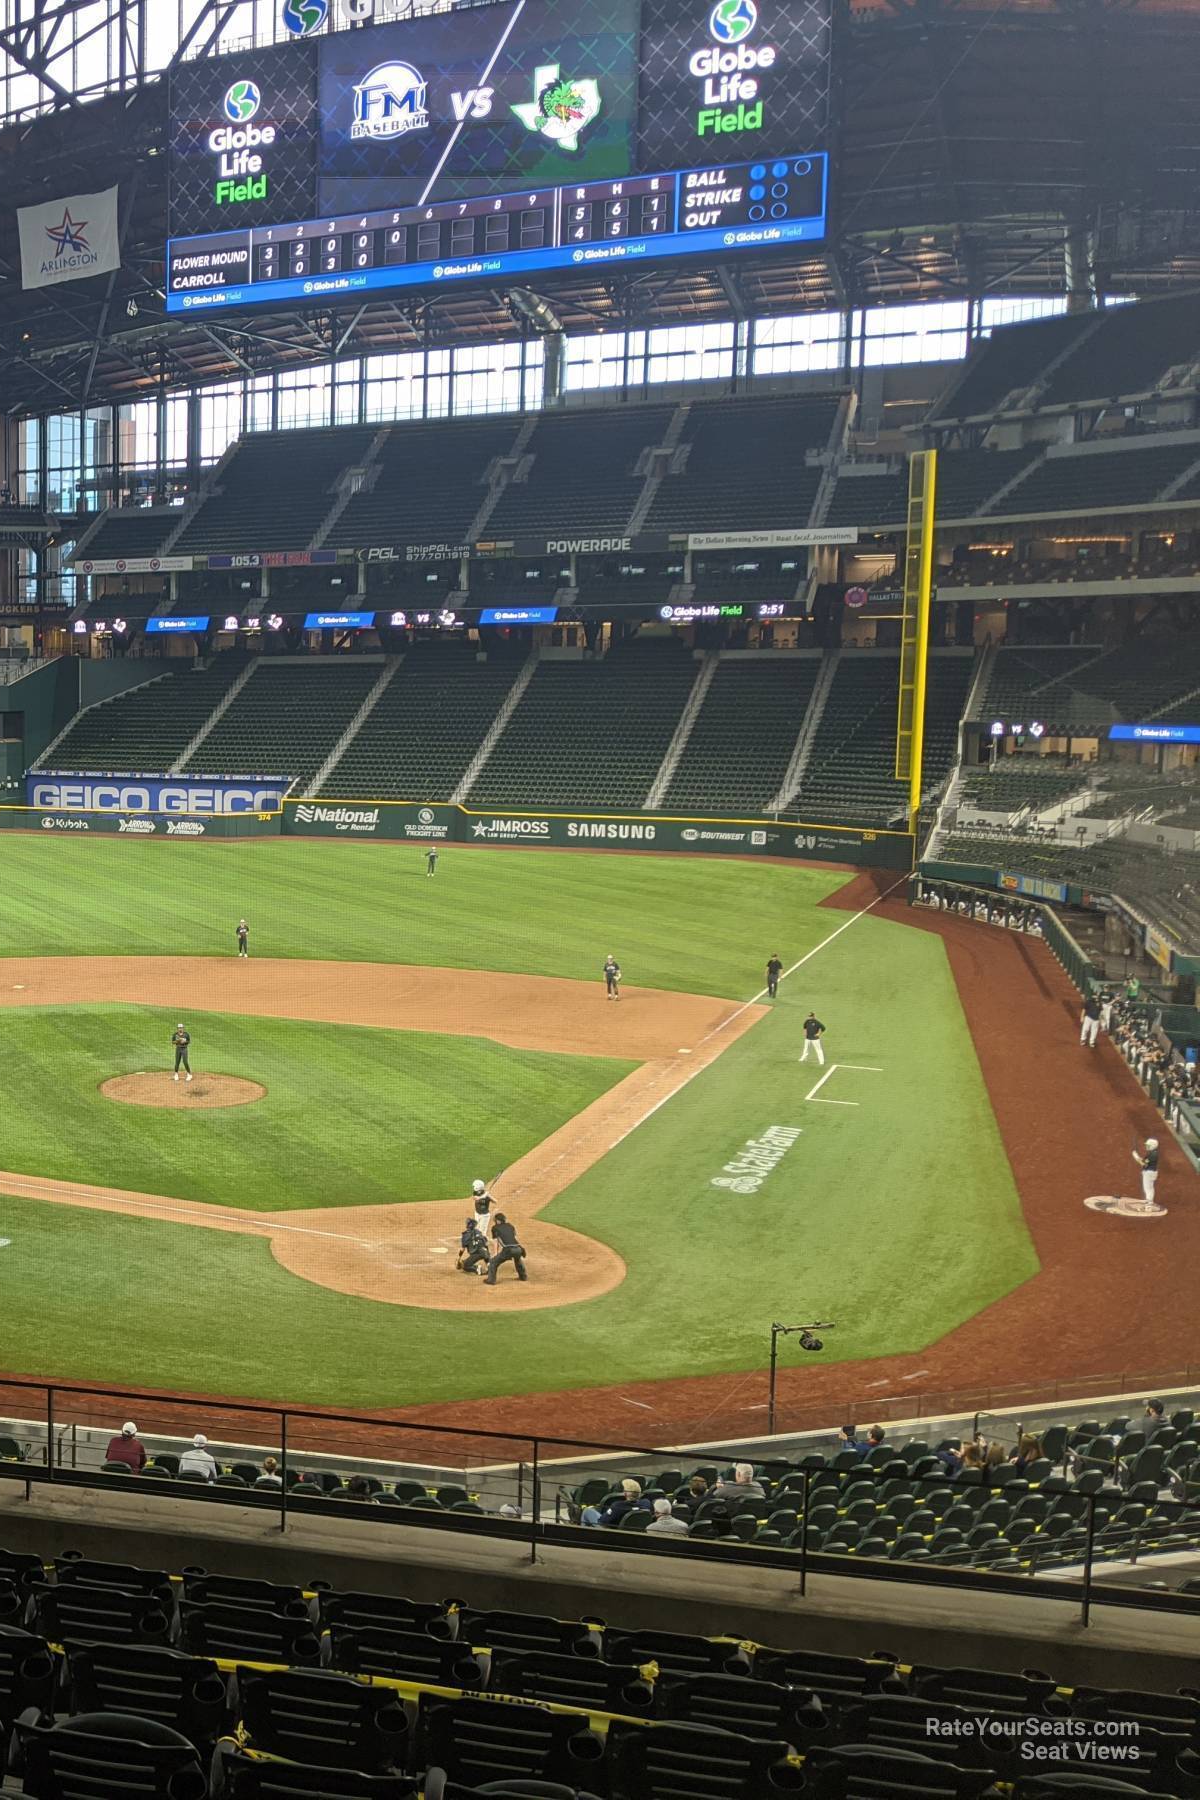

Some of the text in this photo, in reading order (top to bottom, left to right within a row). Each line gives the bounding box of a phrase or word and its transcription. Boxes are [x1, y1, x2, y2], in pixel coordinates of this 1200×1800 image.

[689, 44, 776, 77] Globe
[704, 73, 757, 105] Life
[358, 83, 422, 122] FM
[451, 87, 494, 121] VS
[352, 115, 428, 138] BASEBALL
[698, 101, 763, 136] Field
[209, 124, 276, 151] Globe
[221, 150, 262, 176] Life
[686, 170, 727, 188] BALL
[215, 175, 267, 204] Field
[685, 188, 742, 208] STRIKE
[267, 178, 659, 240] 1 2 3 4 5 6 7 8 9 R H E
[685, 210, 721, 228] OUT
[173, 199, 658, 271] FLOWER MOUND 3 2 0 0 0 5 6 1
[736, 228, 802, 242] Globe Life Field
[173, 218, 658, 289] CARROLL 1 0 3 0 4 5 1
[584, 244, 646, 260] Globe Life Field
[41, 252, 98, 273] ARLINGTON
[444, 260, 500, 276] Globe Life Field
[314, 276, 366, 290] Globe Life Field
[368, 548, 400, 560] PGL
[546, 538, 631, 554] POWERADE
[231, 556, 260, 567] 105.3
[674, 604, 742, 616] Globe Life Field
[760, 604, 785, 614] 3:51
[33, 784, 283, 814] GEICO GEICO
[56, 818, 90, 830] Kubota
[127, 820, 151, 829] ARROW
[174, 822, 200, 830] ARROW
[258, 814, 272, 822] 374
[336, 823, 376, 832] Car Rental
[417, 824, 448, 832] DOMINION
[568, 822, 656, 840] SAMSUNG
[700, 832, 745, 840] SOUTHWEST
[862, 832, 876, 841] 326
